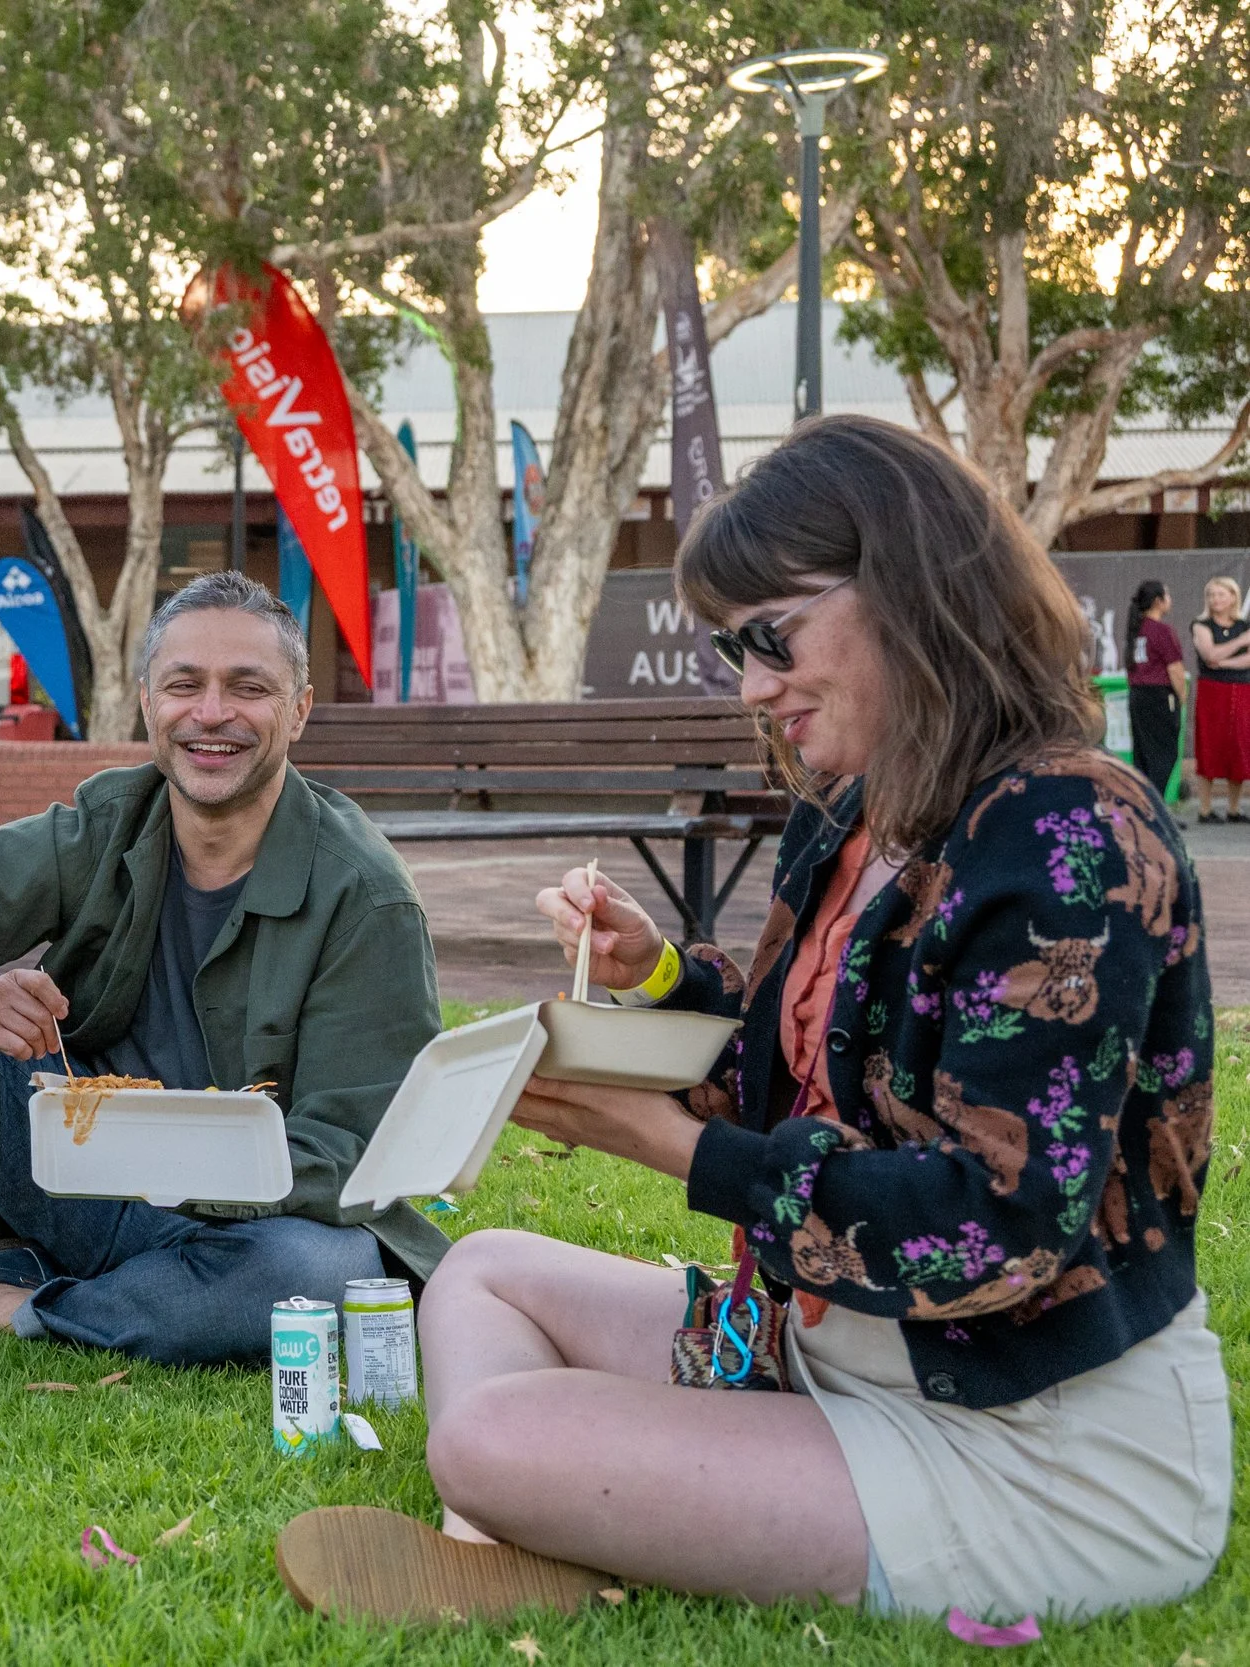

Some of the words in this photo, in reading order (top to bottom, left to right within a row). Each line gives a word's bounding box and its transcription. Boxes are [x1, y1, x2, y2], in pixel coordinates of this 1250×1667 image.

[273, 1338, 303, 1358] Raw
[279, 1369, 308, 1387] PURE
[278, 1385, 309, 1401] COCONUT
[279, 1400, 309, 1415] WATER
